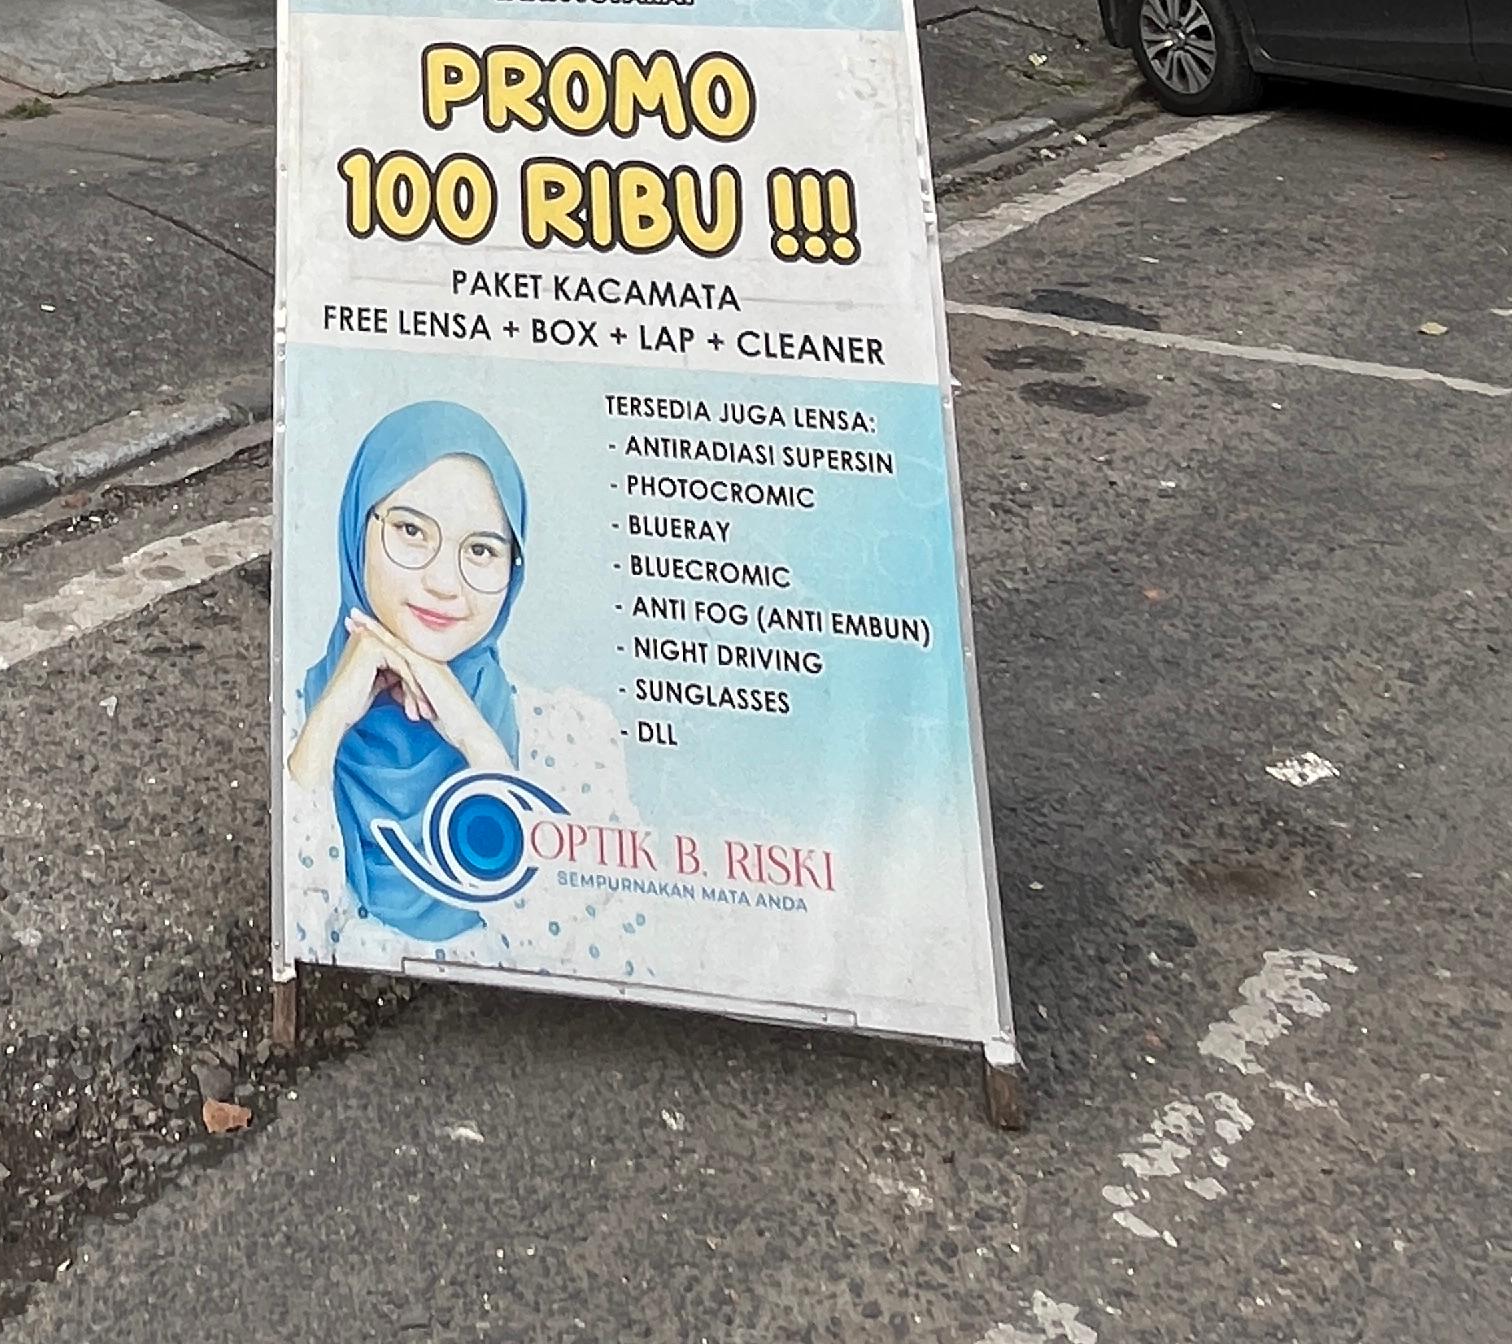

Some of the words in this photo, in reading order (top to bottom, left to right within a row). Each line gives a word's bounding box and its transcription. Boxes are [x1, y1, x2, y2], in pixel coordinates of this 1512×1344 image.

[421, 42, 757, 142] PROMO
[338, 148, 499, 244] 100
[520, 156, 743, 257] RIBU
[767, 167, 862, 266] !!!
[451, 269, 543, 301] PAKET
[553, 275, 742, 312] KACAMATA
[323, 304, 388, 335] FREE
[398, 308, 492, 342] LENSA
[502, 320, 520, 340] +
[531, 318, 599, 349] BOX
[610, 327, 629, 346] +
[639, 323, 696, 355] LAP
[706, 332, 726, 352] +
[736, 330, 887, 368] CLEANER
[605, 394, 711, 422] TERSEDIA
[719, 402, 786, 428] JUGA
[794, 407, 877, 434] LENSA:
[625, 435, 776, 466] ANTIRADIASI
[783, 446, 894, 475] SUPERSIN
[627, 474, 816, 508] PHOTOCROMIC
[629, 514, 730, 543] BLUERAY
[631, 554, 791, 588] BLUECROMIC
[632, 596, 687, 621] ANTI
[695, 601, 749, 626] FOG
[757, 605, 822, 633] (ANTI
[832, 613, 931, 648] EMBUN)
[634, 637, 708, 665] NIGHT
[717, 645, 823, 674] DRIVING
[636, 678, 790, 713] SUNGLASSES
[638, 721, 678, 746] DLL
[530, 820, 658, 872] OPTIK
[674, 834, 708, 878] B.
[724, 840, 836, 891] RISKI
[556, 870, 696, 901] SEMPURNAKAN
[701, 885, 751, 907] MATA
[755, 892, 808, 913] ANDA
